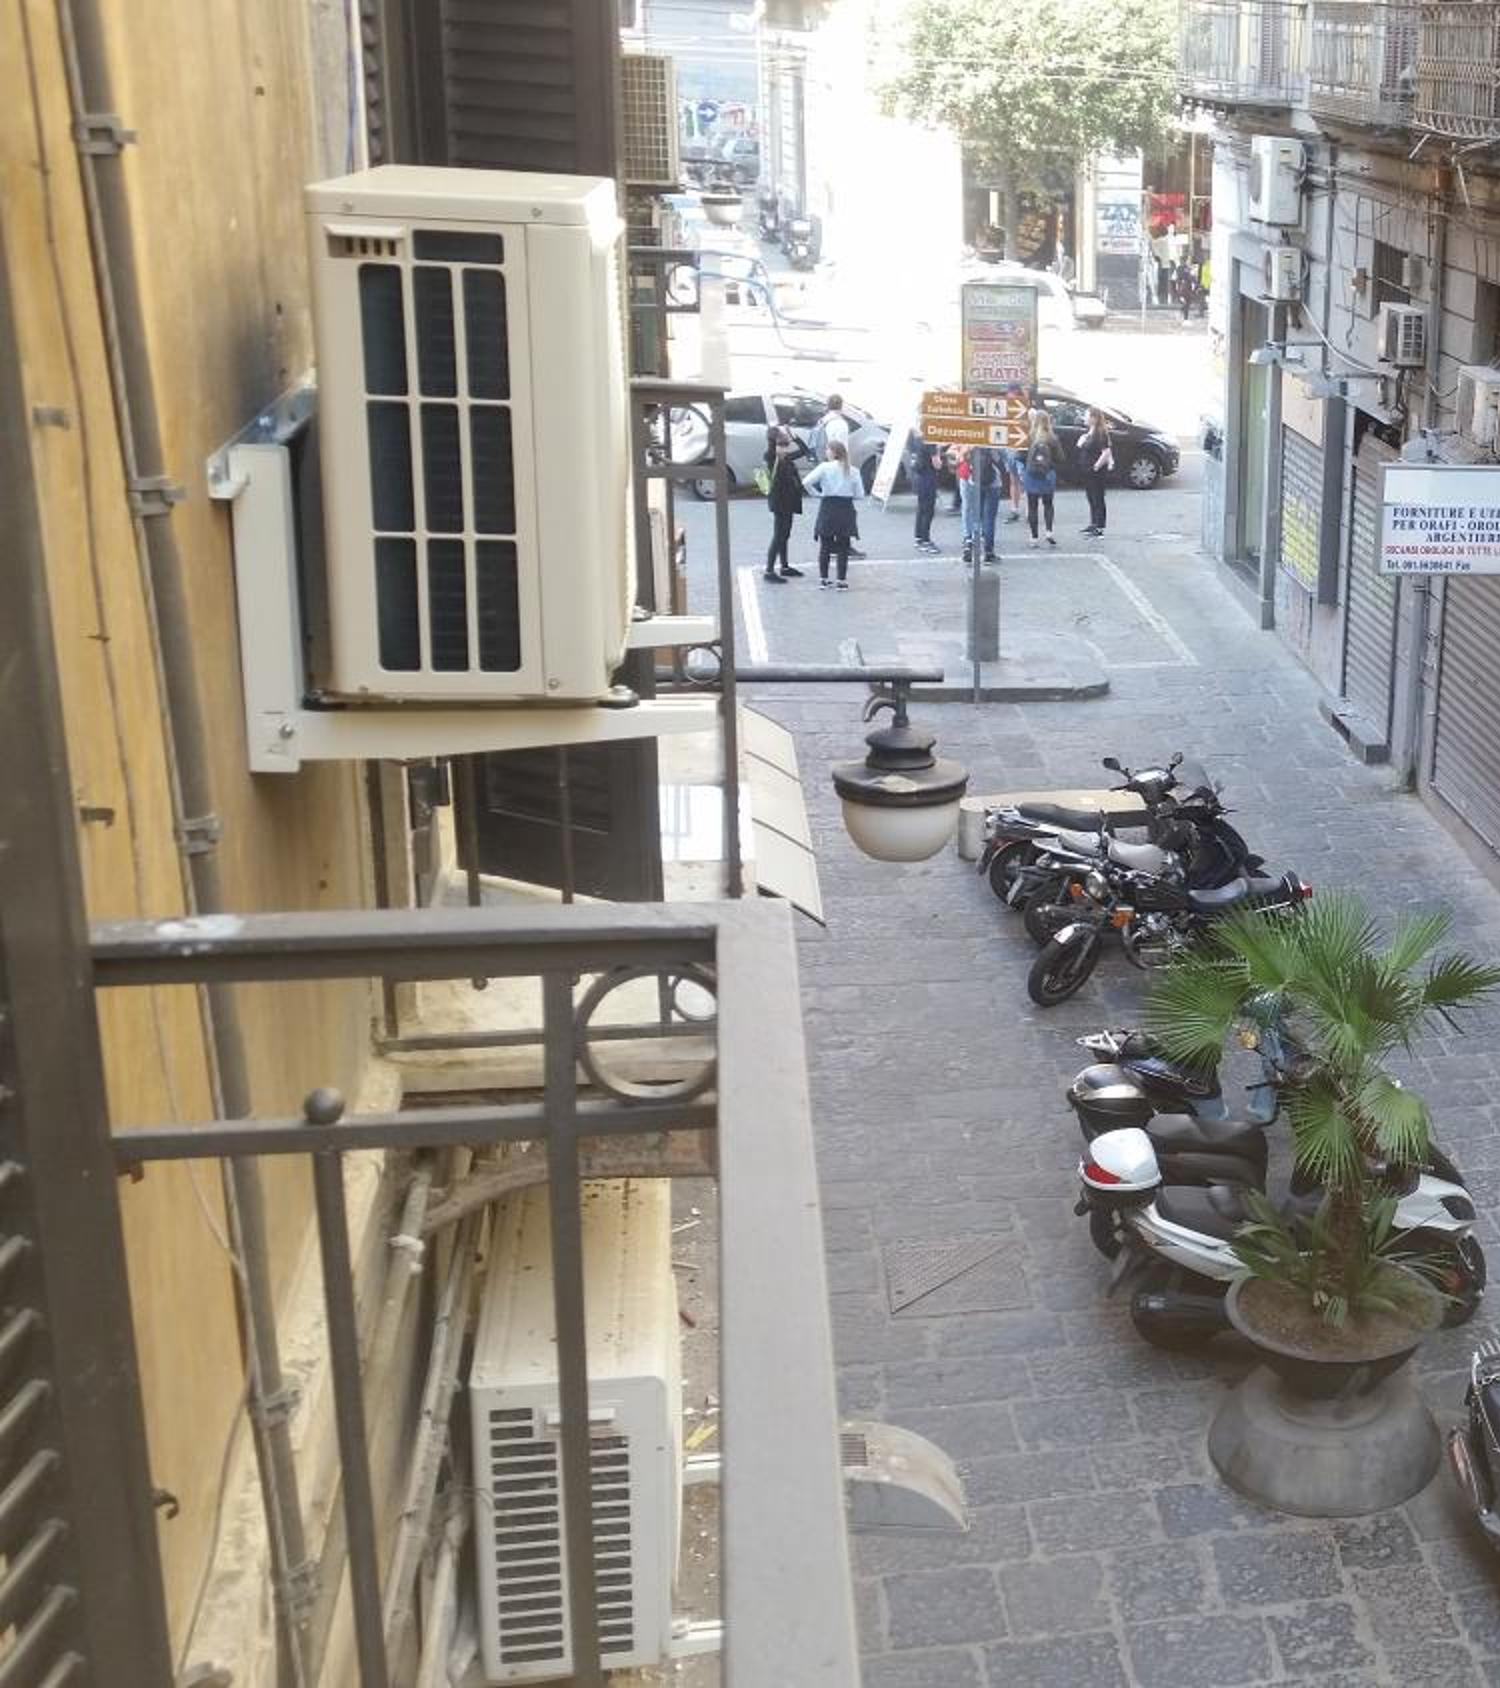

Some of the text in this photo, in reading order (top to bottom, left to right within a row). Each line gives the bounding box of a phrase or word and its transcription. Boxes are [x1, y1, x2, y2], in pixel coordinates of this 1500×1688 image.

[969, 367, 1029, 379] GRATIS
[927, 425, 985, 438] Decumani
[1392, 507, 1464, 519] FORNITURE
[1468, 507, 1477, 519] E
[1392, 519, 1415, 531] PER
[1419, 520, 1457, 531] ORAFI
[1425, 532, 1500, 543] ARGENTIERI
